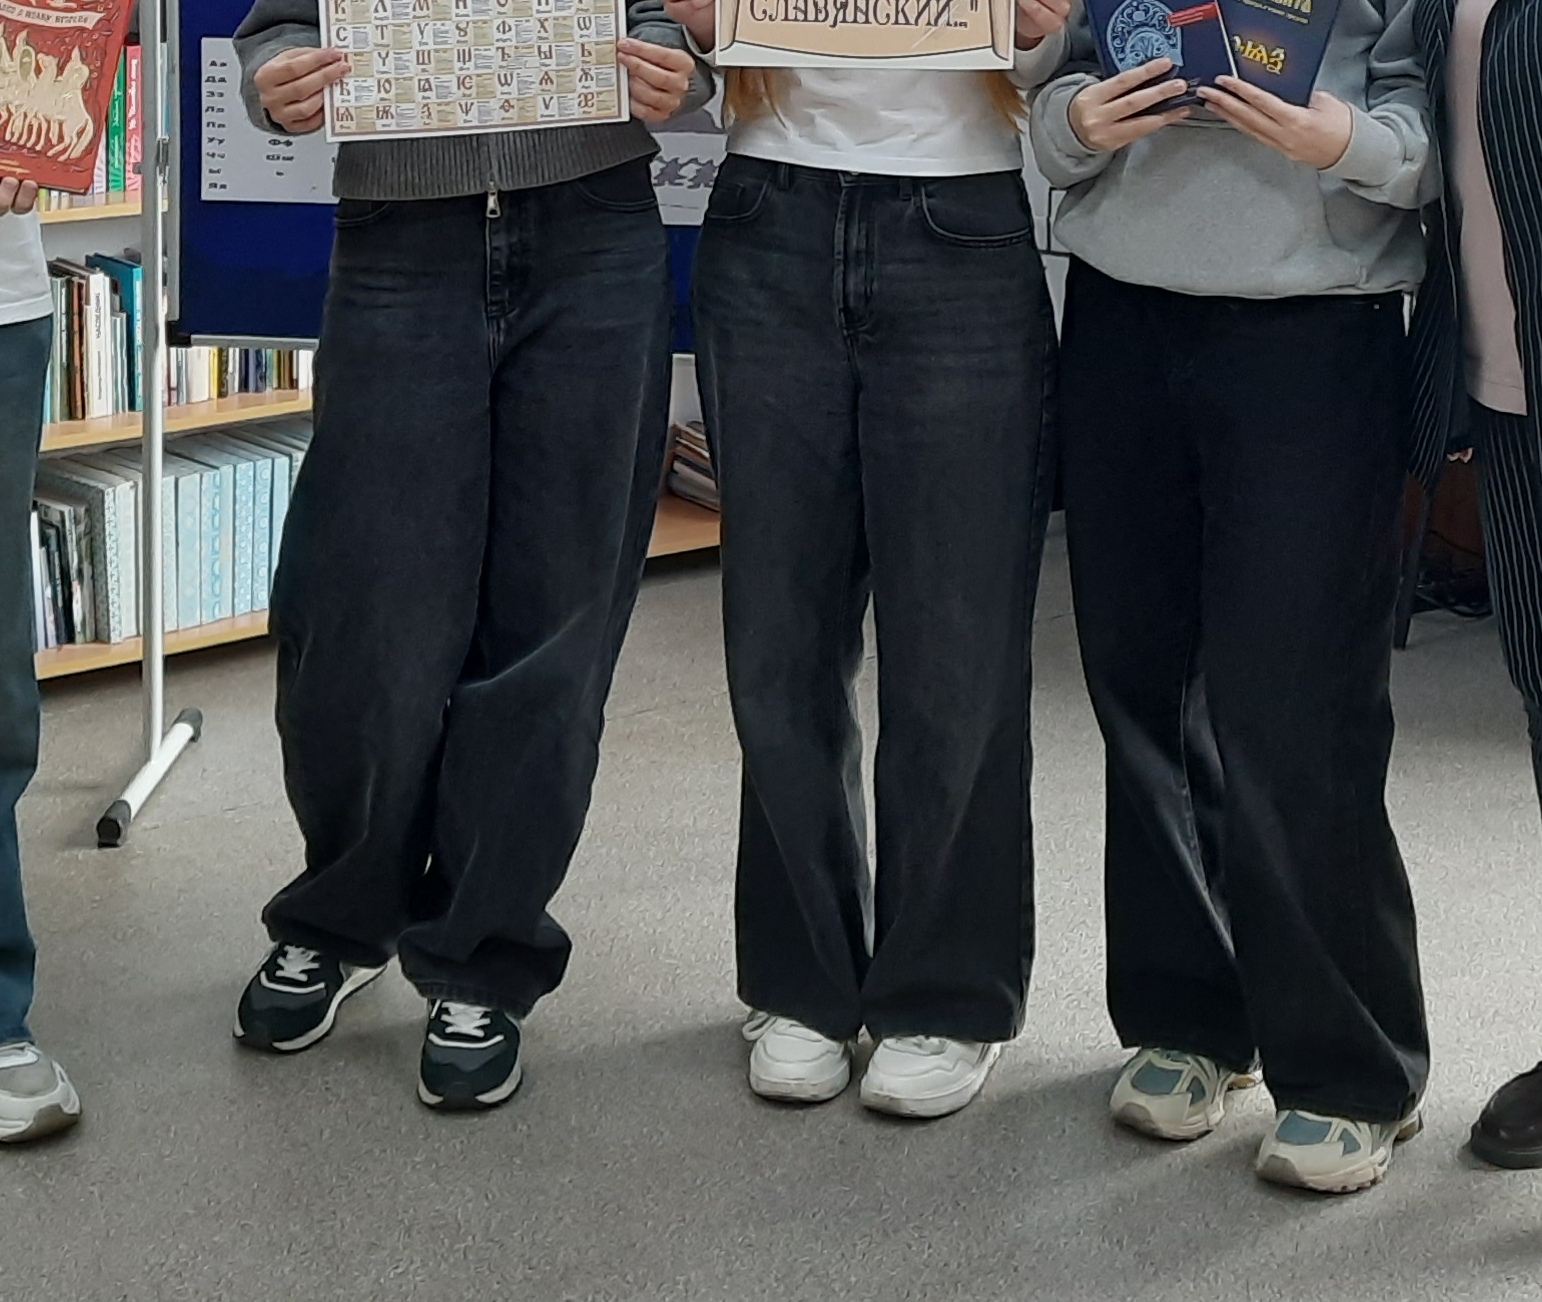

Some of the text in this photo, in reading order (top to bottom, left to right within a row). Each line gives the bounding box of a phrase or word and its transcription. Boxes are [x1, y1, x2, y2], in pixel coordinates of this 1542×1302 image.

[336, 26, 348, 42] С
[375, 25, 388, 41] Т
[537, 18, 549, 34] Х
[416, 49, 432, 66] Ш
